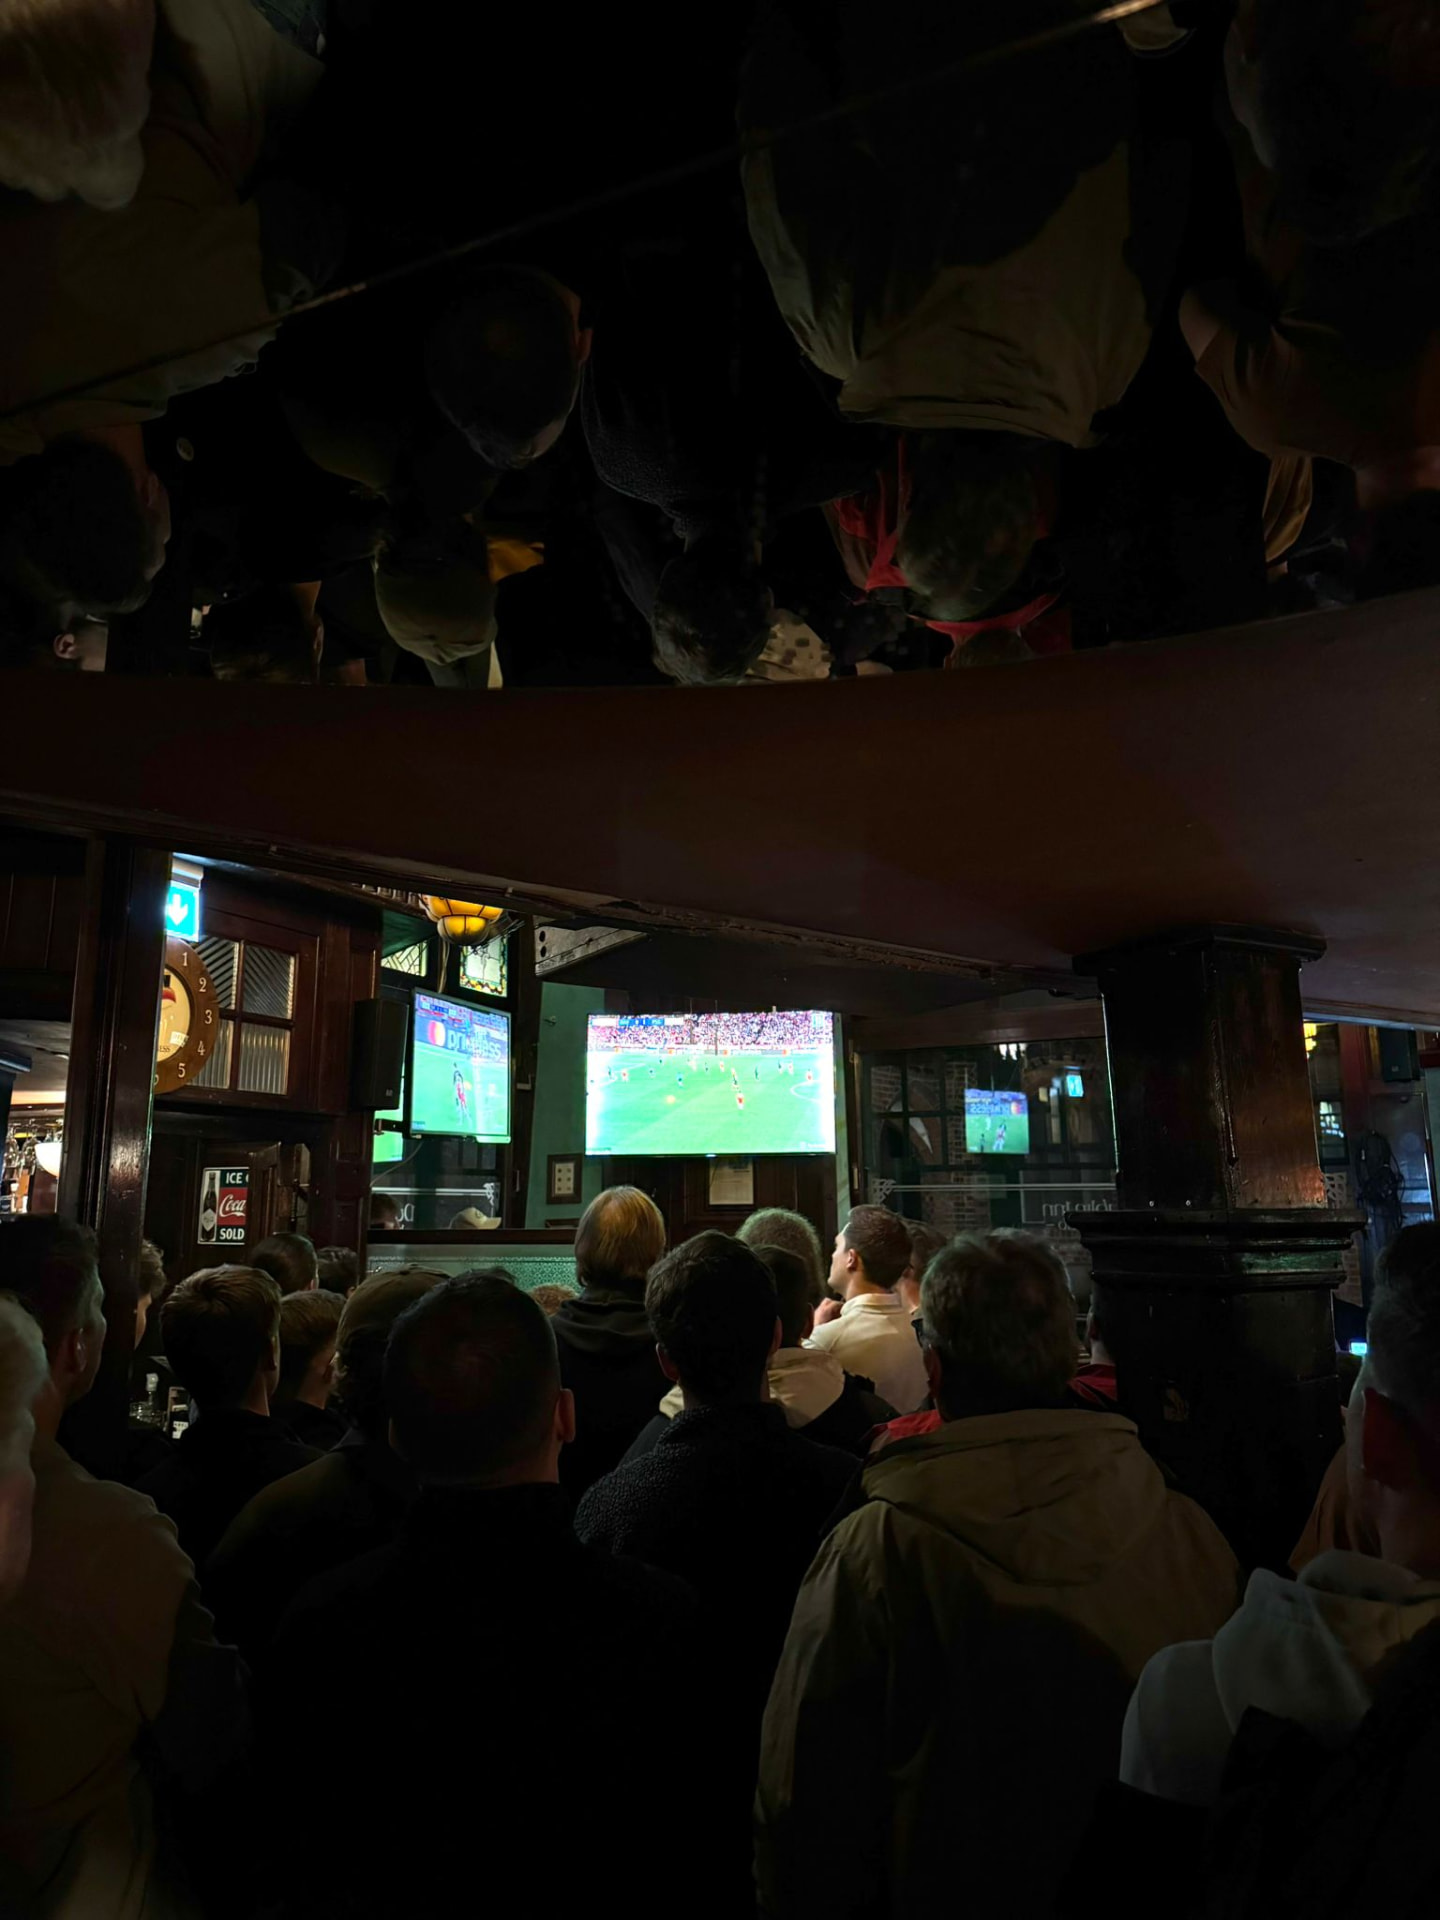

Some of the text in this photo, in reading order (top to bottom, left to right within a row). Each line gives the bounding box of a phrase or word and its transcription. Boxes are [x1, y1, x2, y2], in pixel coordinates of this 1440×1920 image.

[182, 952, 188, 966] 1
[199, 977, 207, 992] 2
[204, 1009, 213, 1024] 3
[197, 1040, 206, 1056] 4
[178, 1063, 186, 1078] 5
[225, 1172, 243, 1184] ICE
[219, 1227, 245, 1240] SOLD
